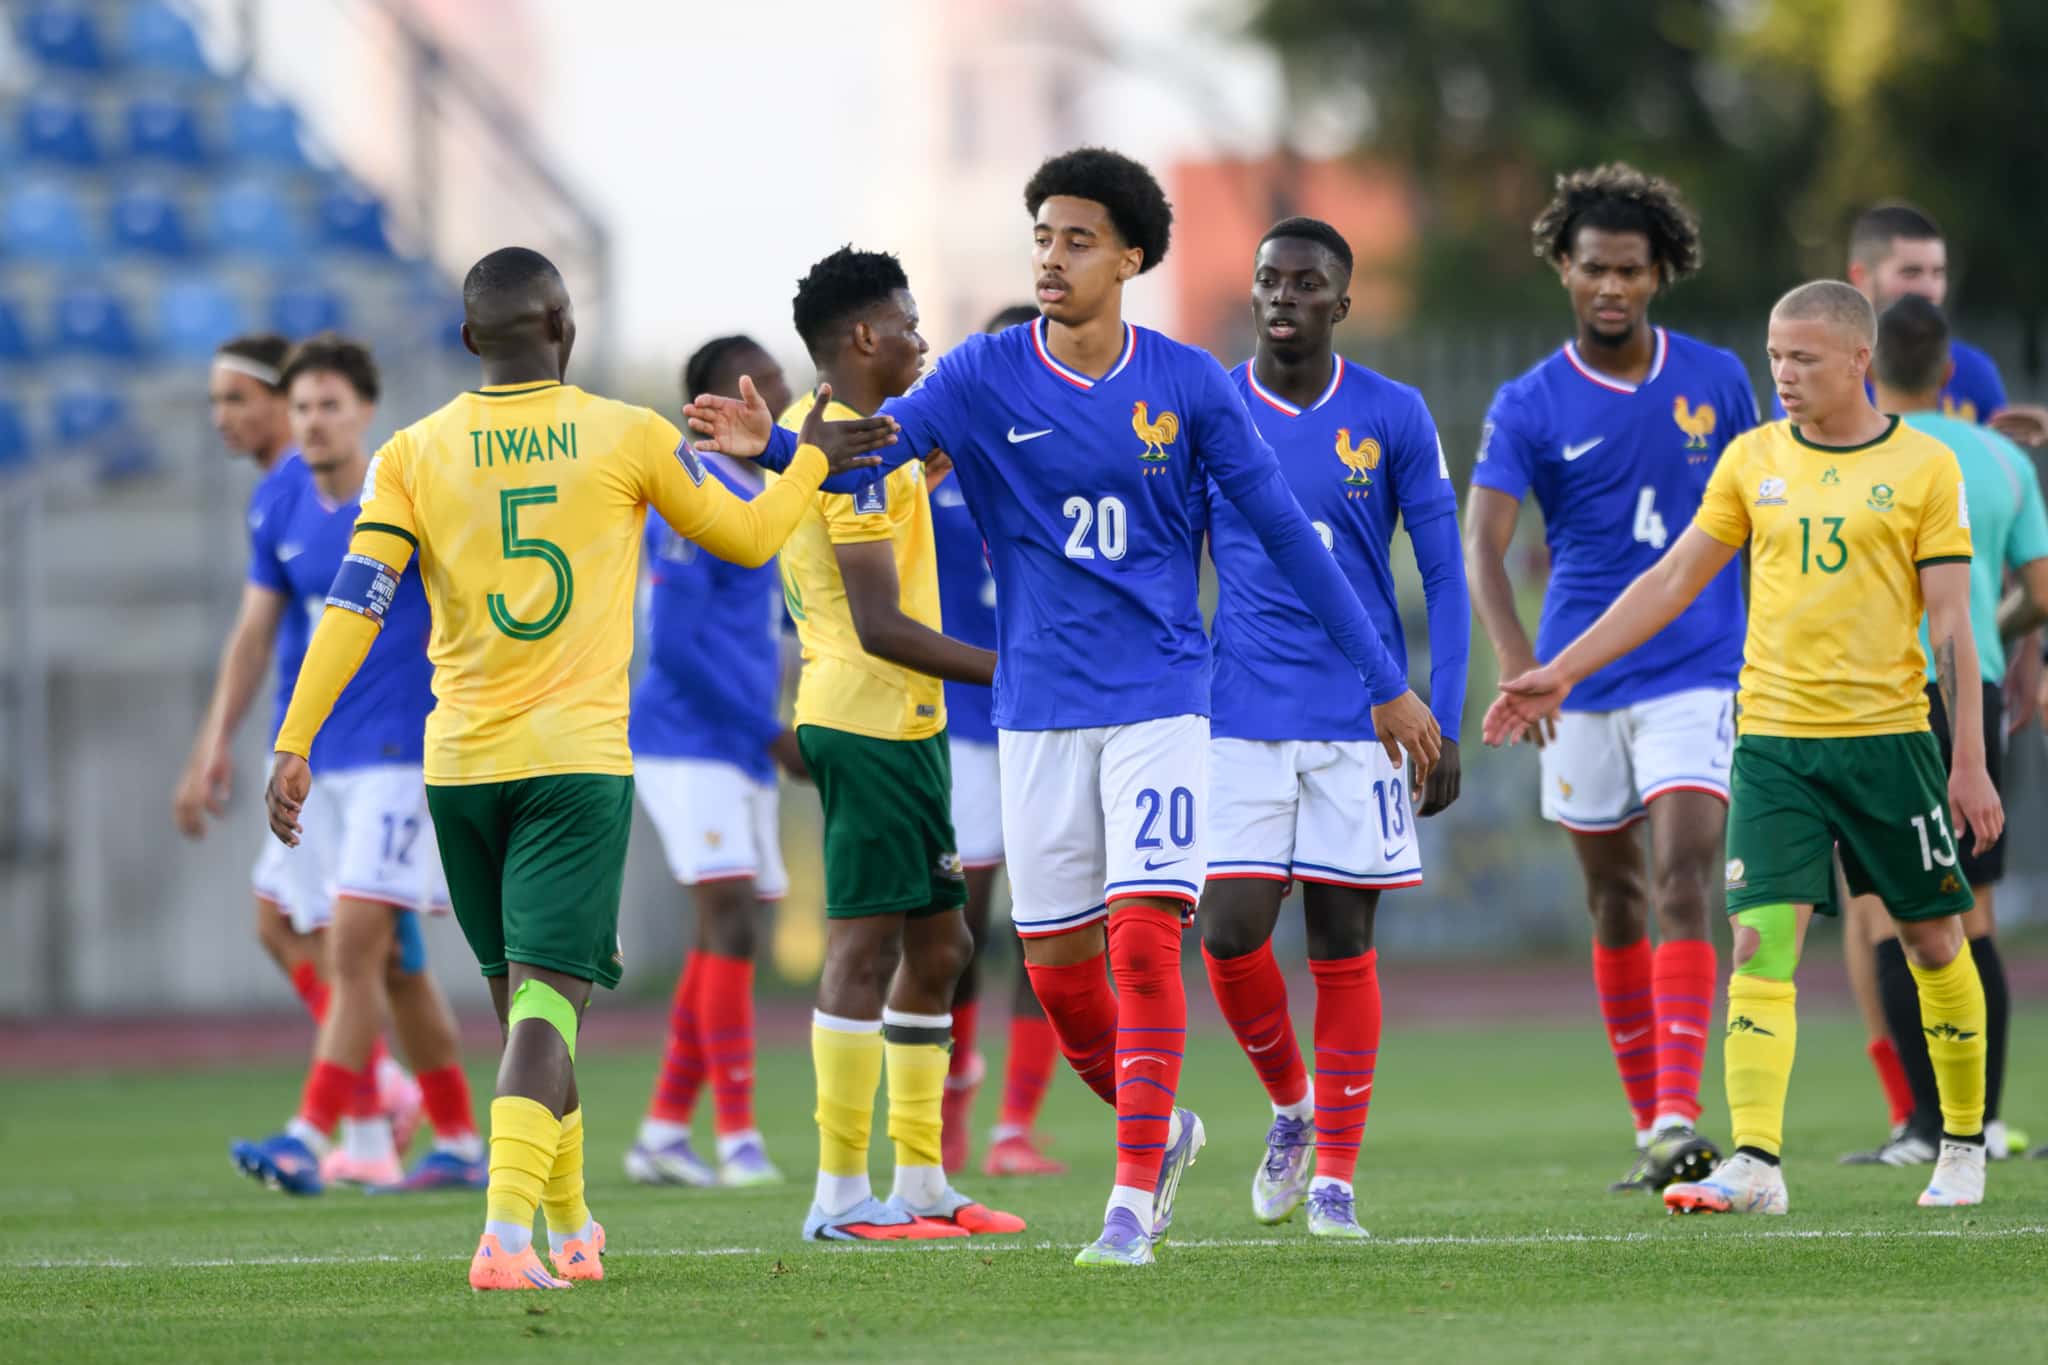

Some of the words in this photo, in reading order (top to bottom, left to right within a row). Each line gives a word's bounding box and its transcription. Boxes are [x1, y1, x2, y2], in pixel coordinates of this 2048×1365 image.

[470, 422, 577, 467] TIWANI
[1063, 496, 1127, 561] 20
[1634, 485, 1668, 549] 4
[1799, 517, 1848, 575] 13
[487, 485, 574, 641] 5
[382, 814, 418, 865] 12
[1135, 786, 1194, 850] 20
[1373, 779, 1404, 839] 13
[1911, 804, 1957, 872] 13
